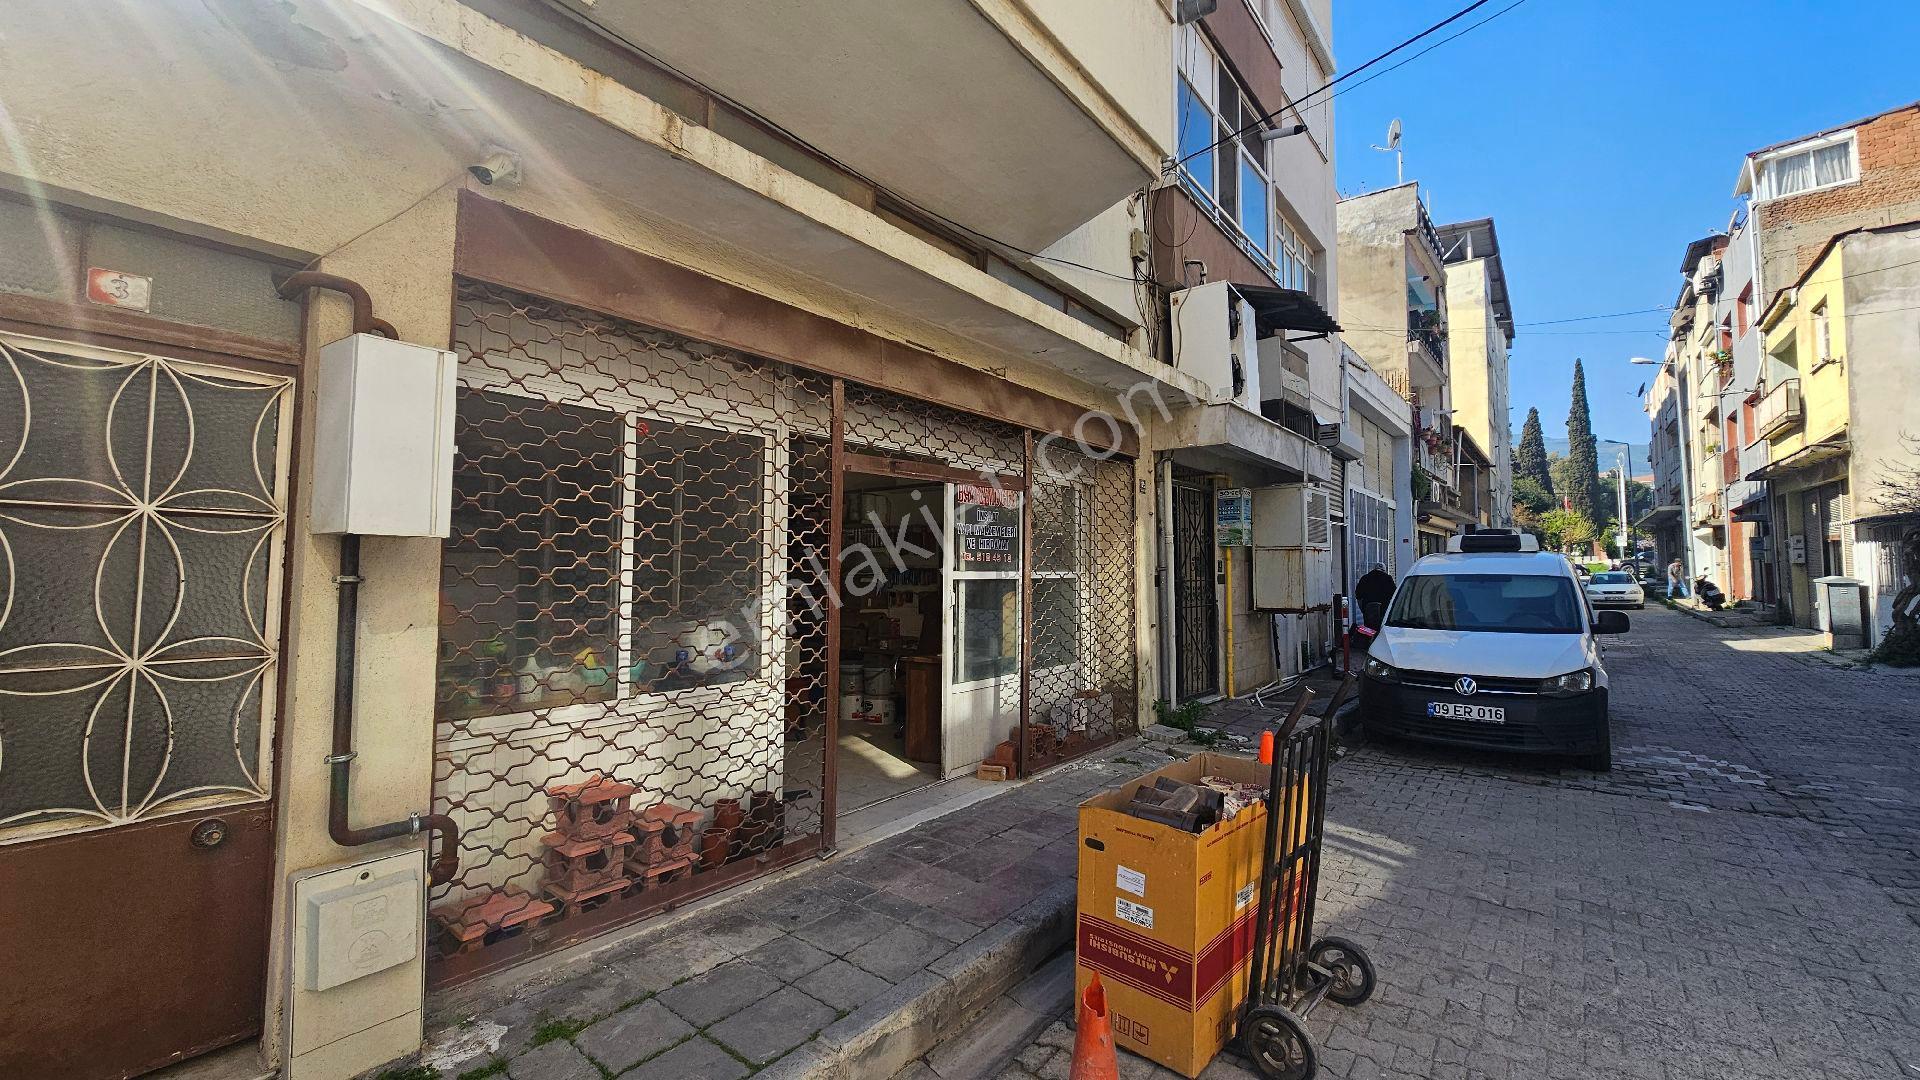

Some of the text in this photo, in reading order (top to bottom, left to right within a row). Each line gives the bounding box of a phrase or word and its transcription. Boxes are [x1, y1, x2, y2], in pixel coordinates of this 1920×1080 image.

[109, 278, 130, 299] 3
[1434, 703, 1450, 716] 09
[1453, 705, 1473, 718] ER
[1477, 707, 1503, 720] 016
[1089, 938, 1156, 972] MITSUBISHI
